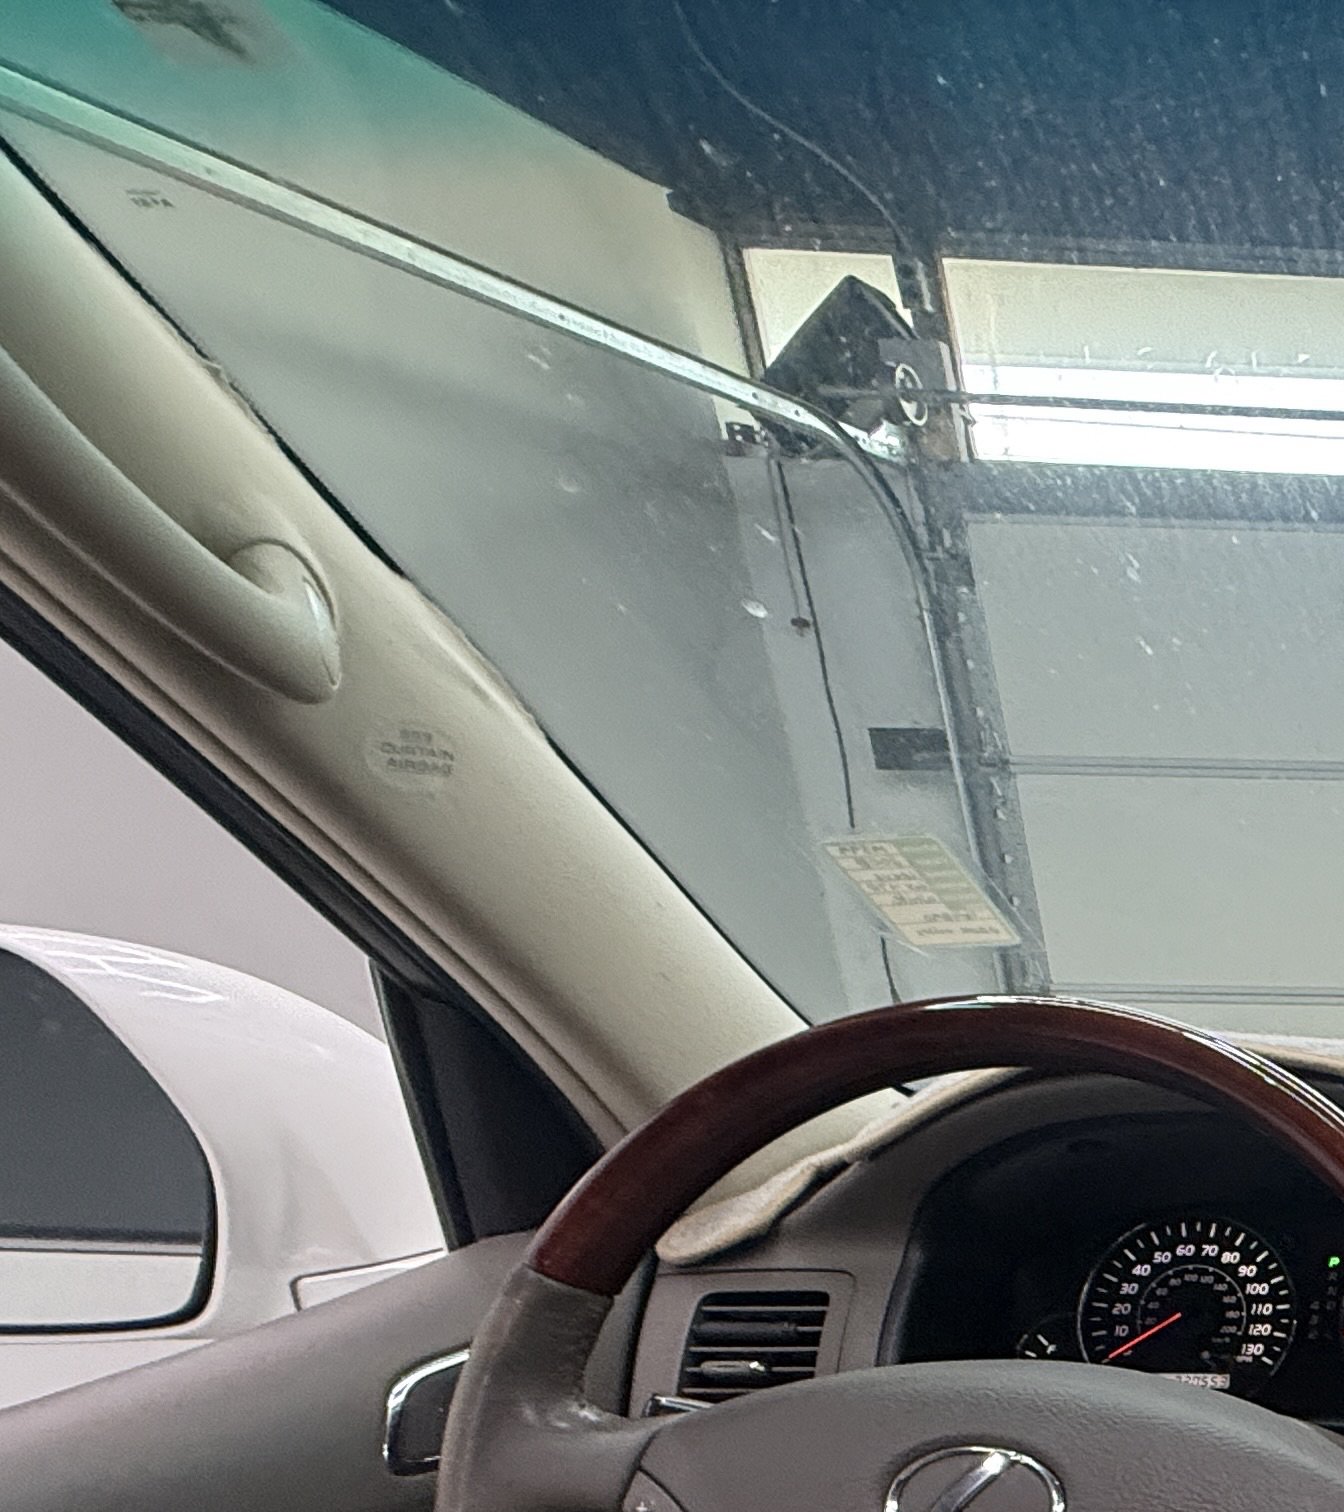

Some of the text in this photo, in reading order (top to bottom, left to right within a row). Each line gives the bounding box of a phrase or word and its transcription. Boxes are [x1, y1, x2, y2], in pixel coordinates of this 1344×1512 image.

[1176, 1244, 1195, 1257] 60
[1201, 1244, 1219, 1257] 70
[1152, 1251, 1172, 1264] 50
[1221, 1252, 1240, 1264] 80
[1328, 1256, 1340, 1268] P
[1132, 1264, 1151, 1277] 40
[1237, 1265, 1257, 1277] 90
[1120, 1283, 1139, 1295] 30
[1245, 1283, 1270, 1295] 100
[1112, 1303, 1132, 1315] 20
[1250, 1303, 1273, 1315] 110
[1114, 1325, 1129, 1337] 10
[1248, 1324, 1272, 1336] 120
[1241, 1343, 1264, 1355] 130
